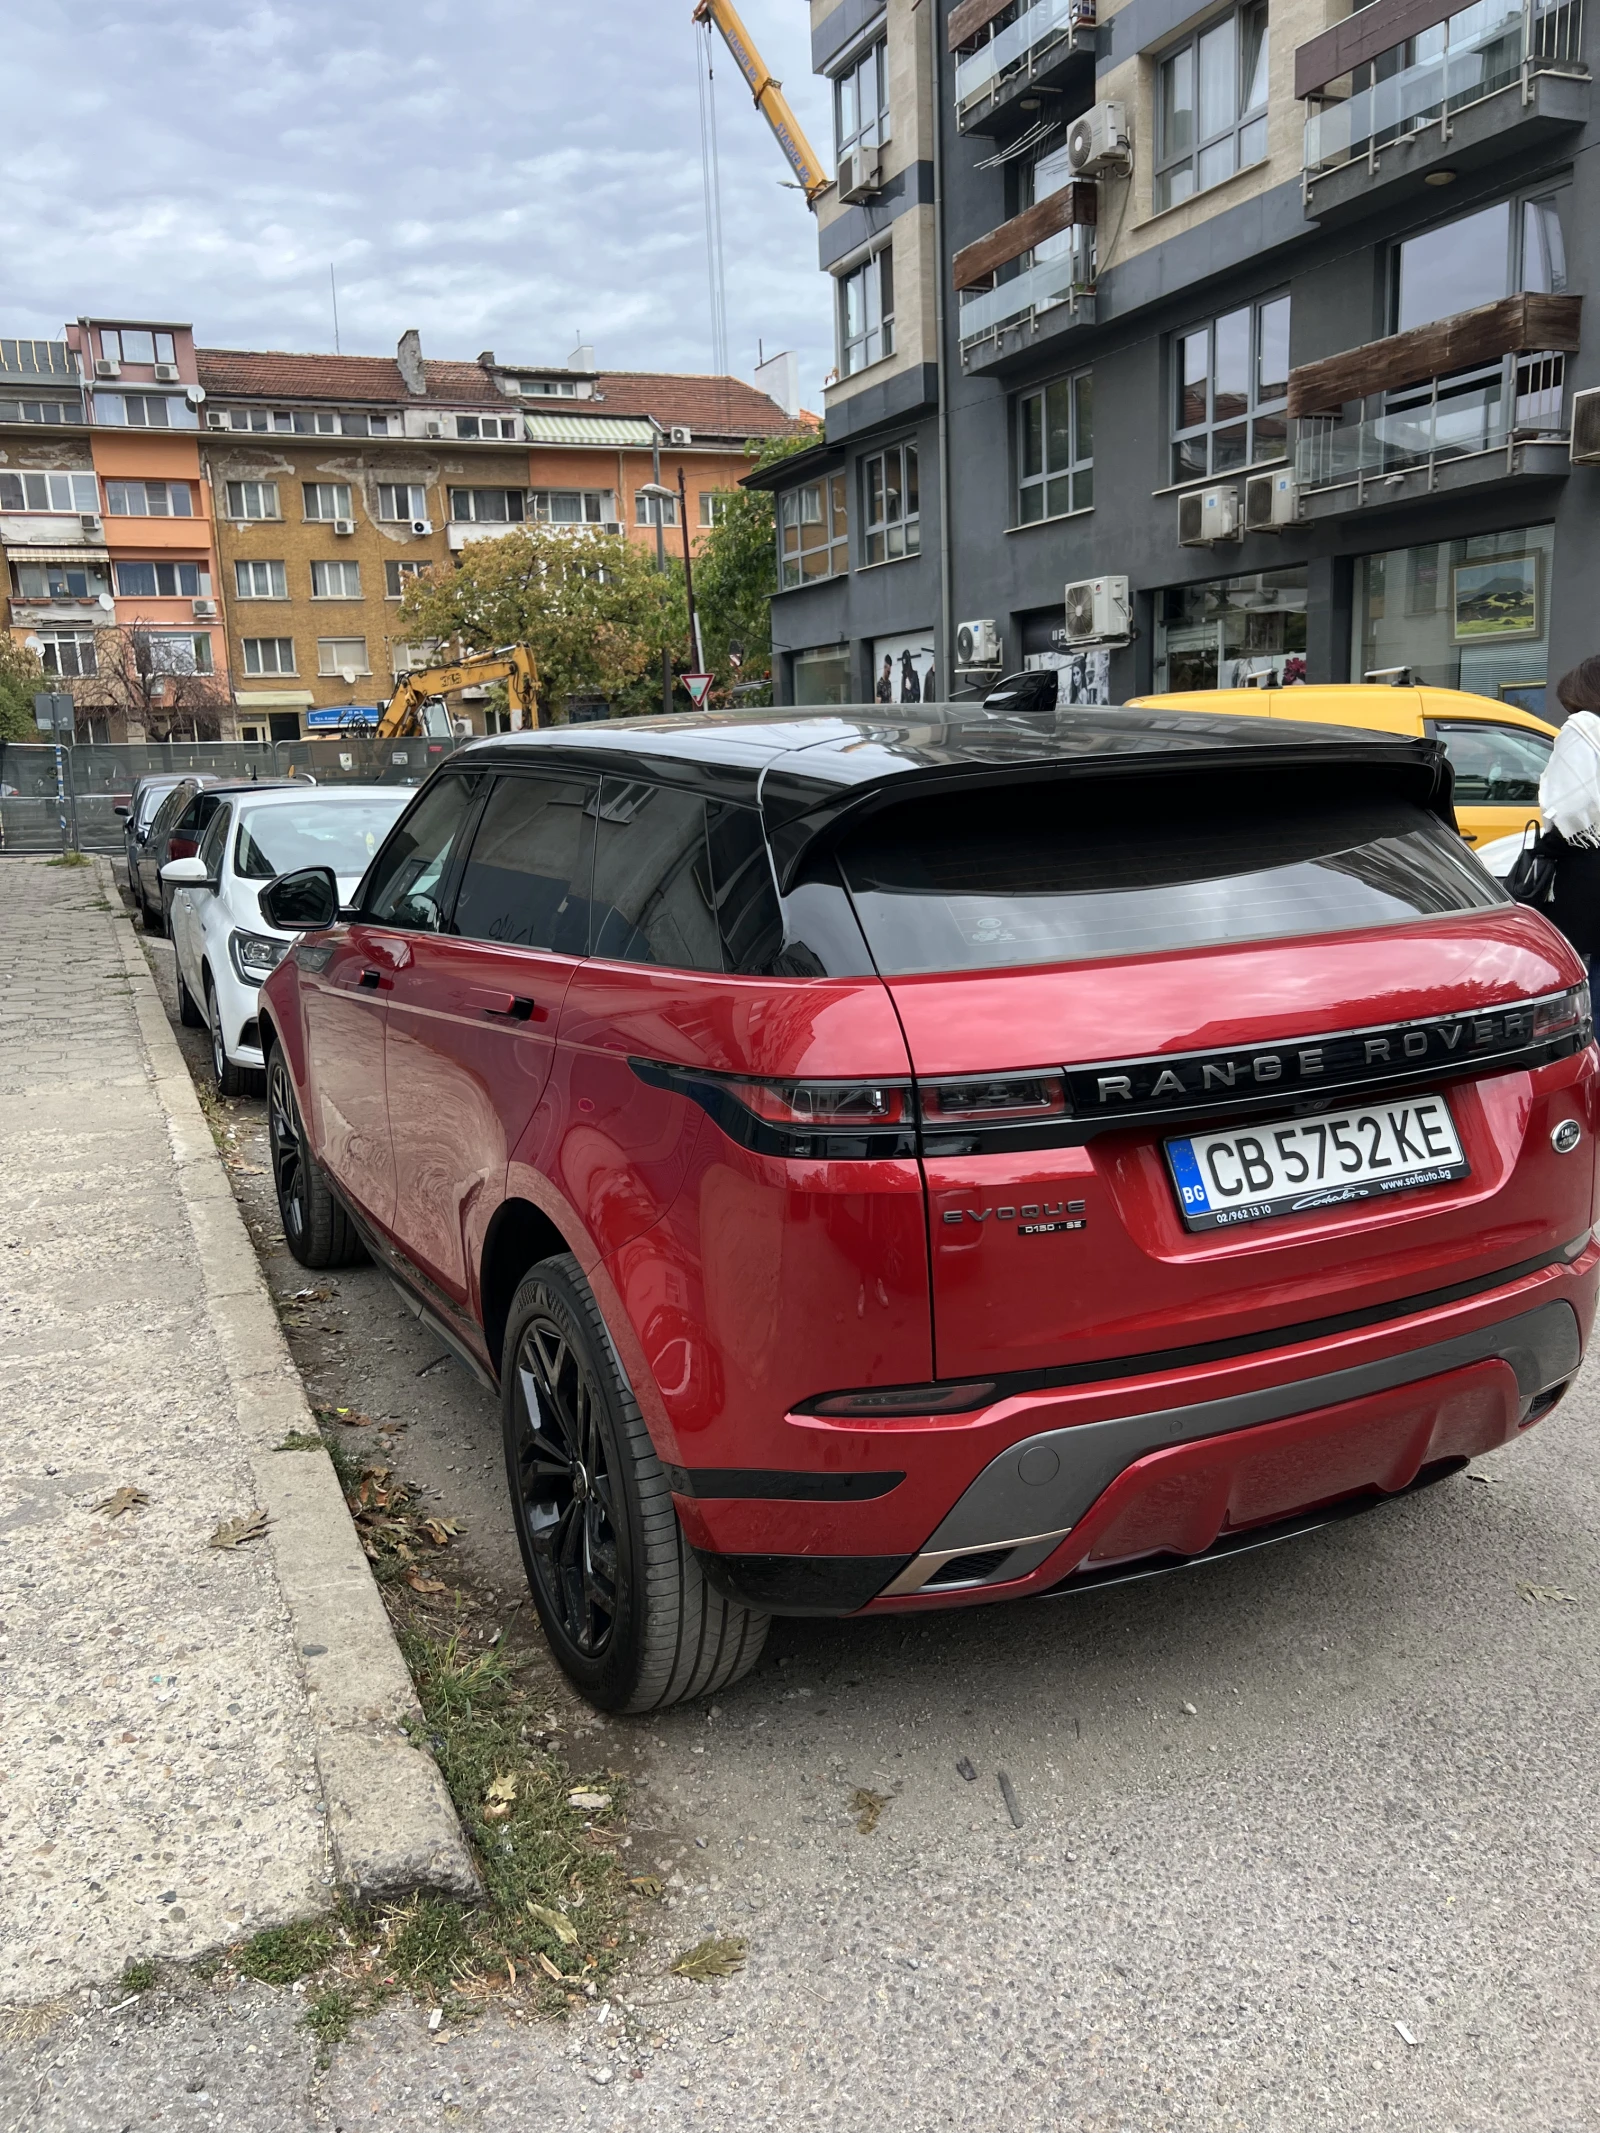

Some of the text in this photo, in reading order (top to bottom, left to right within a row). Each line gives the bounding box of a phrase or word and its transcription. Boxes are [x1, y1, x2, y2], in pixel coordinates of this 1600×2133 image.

[727, 29, 758, 82] STAIGER BG
[775, 122, 811, 184] STAIGER BG
[1097, 1012, 1526, 1102] RANGE ROVER
[1182, 1185, 1205, 1204] BG
[1380, 1169, 1452, 1192] www.sofauto.bg
[943, 1200, 1086, 1223] EVOQUE
